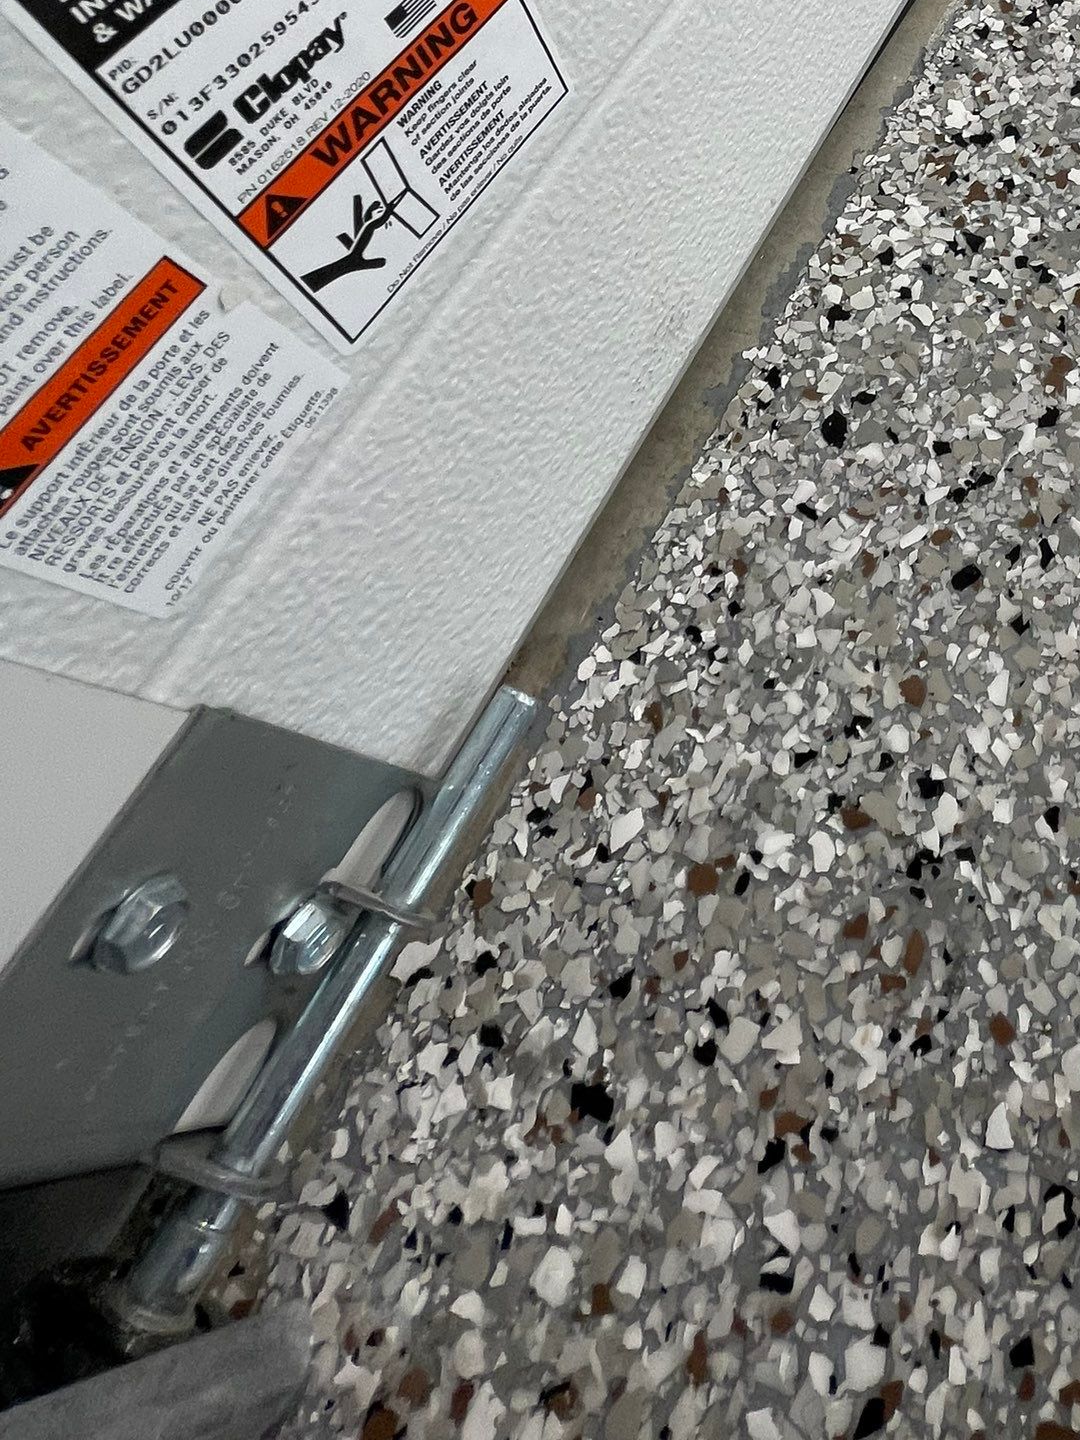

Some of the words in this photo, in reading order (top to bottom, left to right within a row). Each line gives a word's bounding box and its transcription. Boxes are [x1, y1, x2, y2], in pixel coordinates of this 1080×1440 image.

[92, 22, 118, 43] &
[146, 93, 179, 120] S/N:
[258, 107, 289, 137] DUKE
[291, 78, 319, 107] BLVD
[308, 2, 479, 168] WARNING
[396, 80, 443, 128] WARNING
[403, 112, 428, 138] Keep
[426, 82, 458, 113] fingers
[457, 59, 477, 83] clear
[410, 132, 421, 147] of
[420, 101, 452, 136] section
[450, 77, 475, 105] joints
[419, 80, 488, 160] AVERTISSEMENT
[235, 135, 281, 176] MASON,
[283, 113, 300, 130] OH
[237, 183, 258, 205] PN
[304, 111, 329, 138] REV
[329, 71, 371, 113] 12-2020
[431, 156, 448, 175] des
[447, 120, 481, 158] sections
[480, 108, 491, 121] de
[490, 85, 512, 111] porte
[438, 108, 505, 188] AVERTISSEMENT
[18, 227, 114, 313] instructions.
[25, 230, 80, 283] person
[27, 226, 55, 246] be
[398, 262, 414, 280] Not
[19, 278, 179, 453] AVERTISSEMENT
[33, 339, 66, 374] over
[63, 308, 97, 339] this
[14, 496, 72, 557] attaches
[67, 446, 114, 494] rouges
[110, 413, 142, 445] sont
[137, 366, 183, 414] soumis
[180, 341, 204, 365] aux
[15, 471, 70, 529] support
[118, 394, 138, 411] de
[132, 379, 151, 393] la
[147, 344, 181, 381] porte
[179, 329, 195, 343] et
[187, 310, 211, 330] les
[27, 494, 93, 562] NIVEAUX
[85, 471, 111, 493] DE
[202, 331, 231, 359] DES
[168, 460, 182, 474] et
[179, 387, 243, 460] ajustements
[241, 342, 280, 386] doivent
[170, 470, 191, 494] par
[189, 452, 208, 469] un
[256, 372, 272, 388] de
[44, 486, 117, 567] RESSORTS
[115, 471, 133, 486] et
[128, 417, 178, 472] peuvent
[174, 374, 212, 417] causer
[210, 357, 228, 374] de
[62, 526, 107, 573] graves
[99, 460, 160, 524] blessures
[158, 441, 177, 459] ou
[171, 427, 189, 440] la
[185, 394, 218, 425] mort.
[164, 501, 185, 522] qui
[182, 484, 199, 500] se
[196, 457, 221, 483] sert
[217, 435, 238, 457] des
[236, 400, 266, 433] outils
[197, 507, 218, 527] NE
[213, 478, 239, 506] PAS
[123, 540, 170, 594] corrects
[168, 524, 182, 538] et
[180, 498, 204, 523] suit
[198, 479, 219, 498] les
[217, 421, 265, 478] directives
[164, 546, 203, 591] couvrir
[201, 526, 219, 544] ou
[215, 470, 260, 526] peinturer
